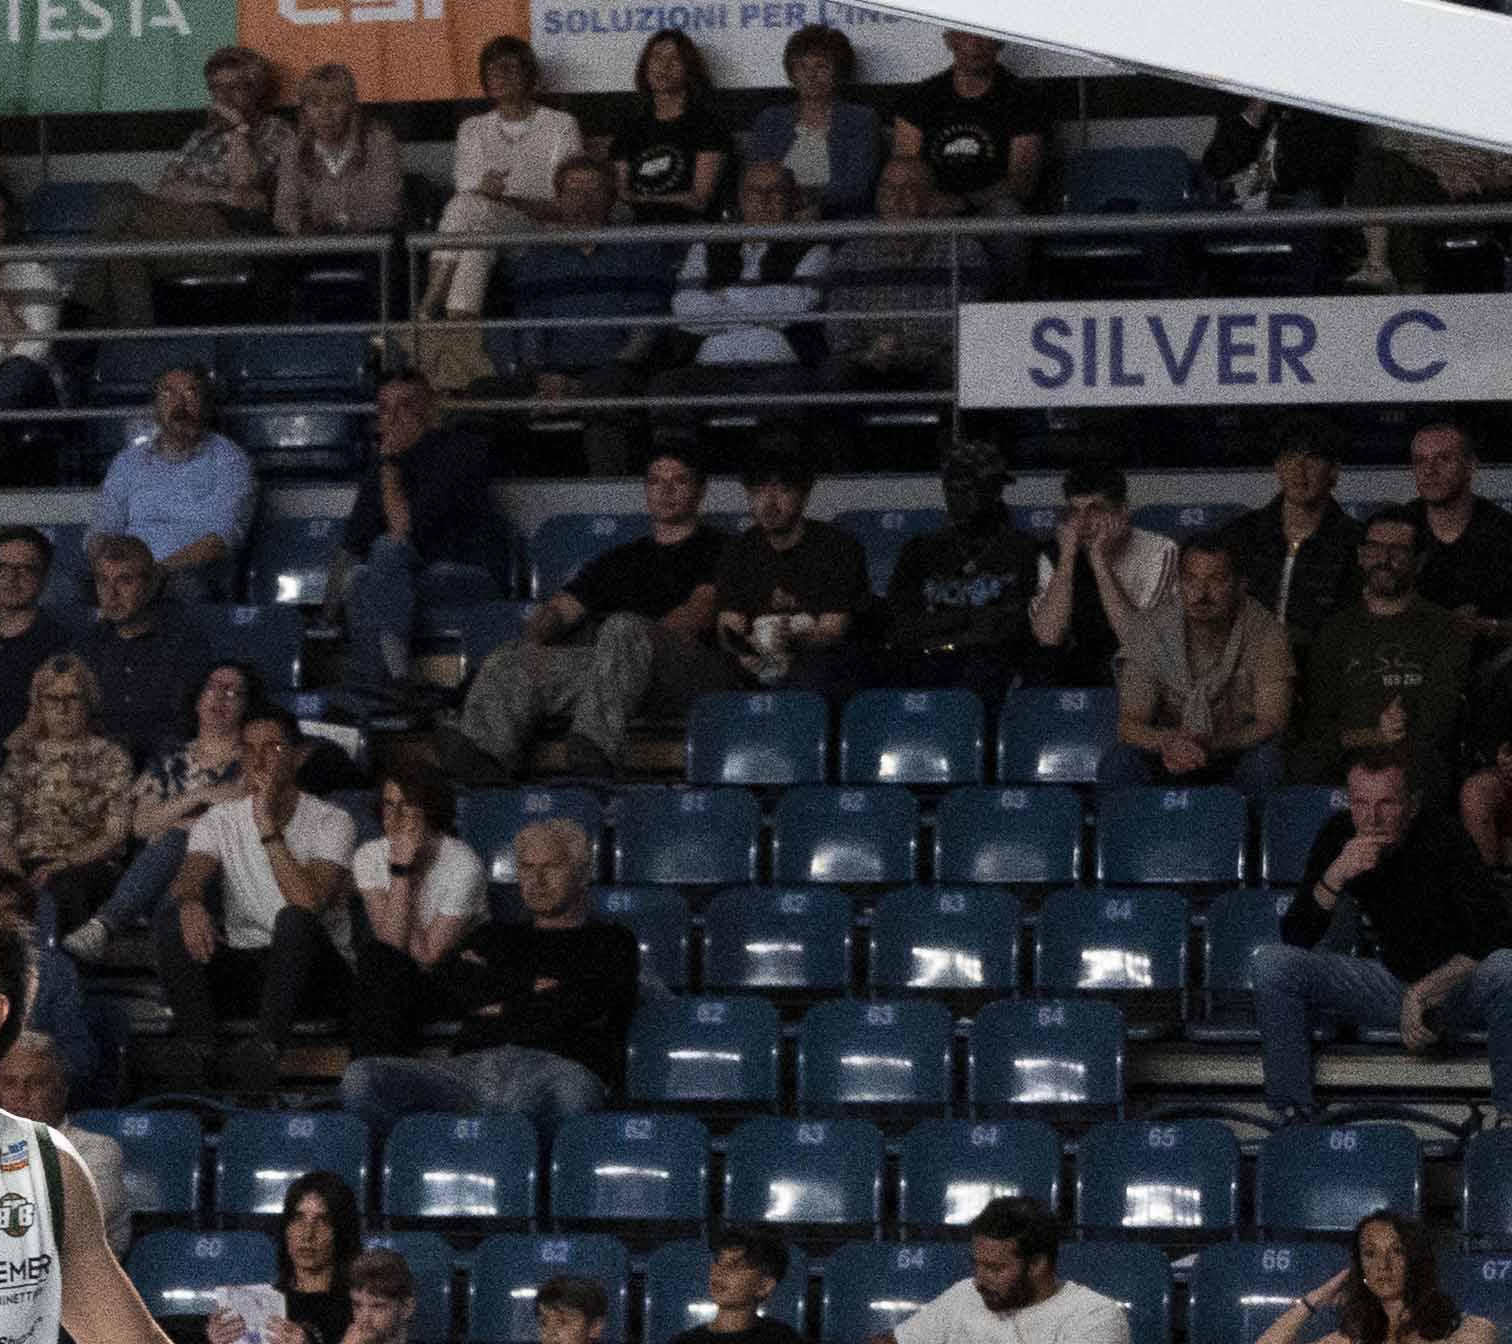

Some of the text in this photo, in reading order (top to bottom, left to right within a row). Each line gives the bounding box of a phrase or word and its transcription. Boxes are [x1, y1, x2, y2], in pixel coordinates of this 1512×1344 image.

[543, 3, 806, 36] SOLUZIONI PER
[1026, 307, 1449, 391] SILVER C
